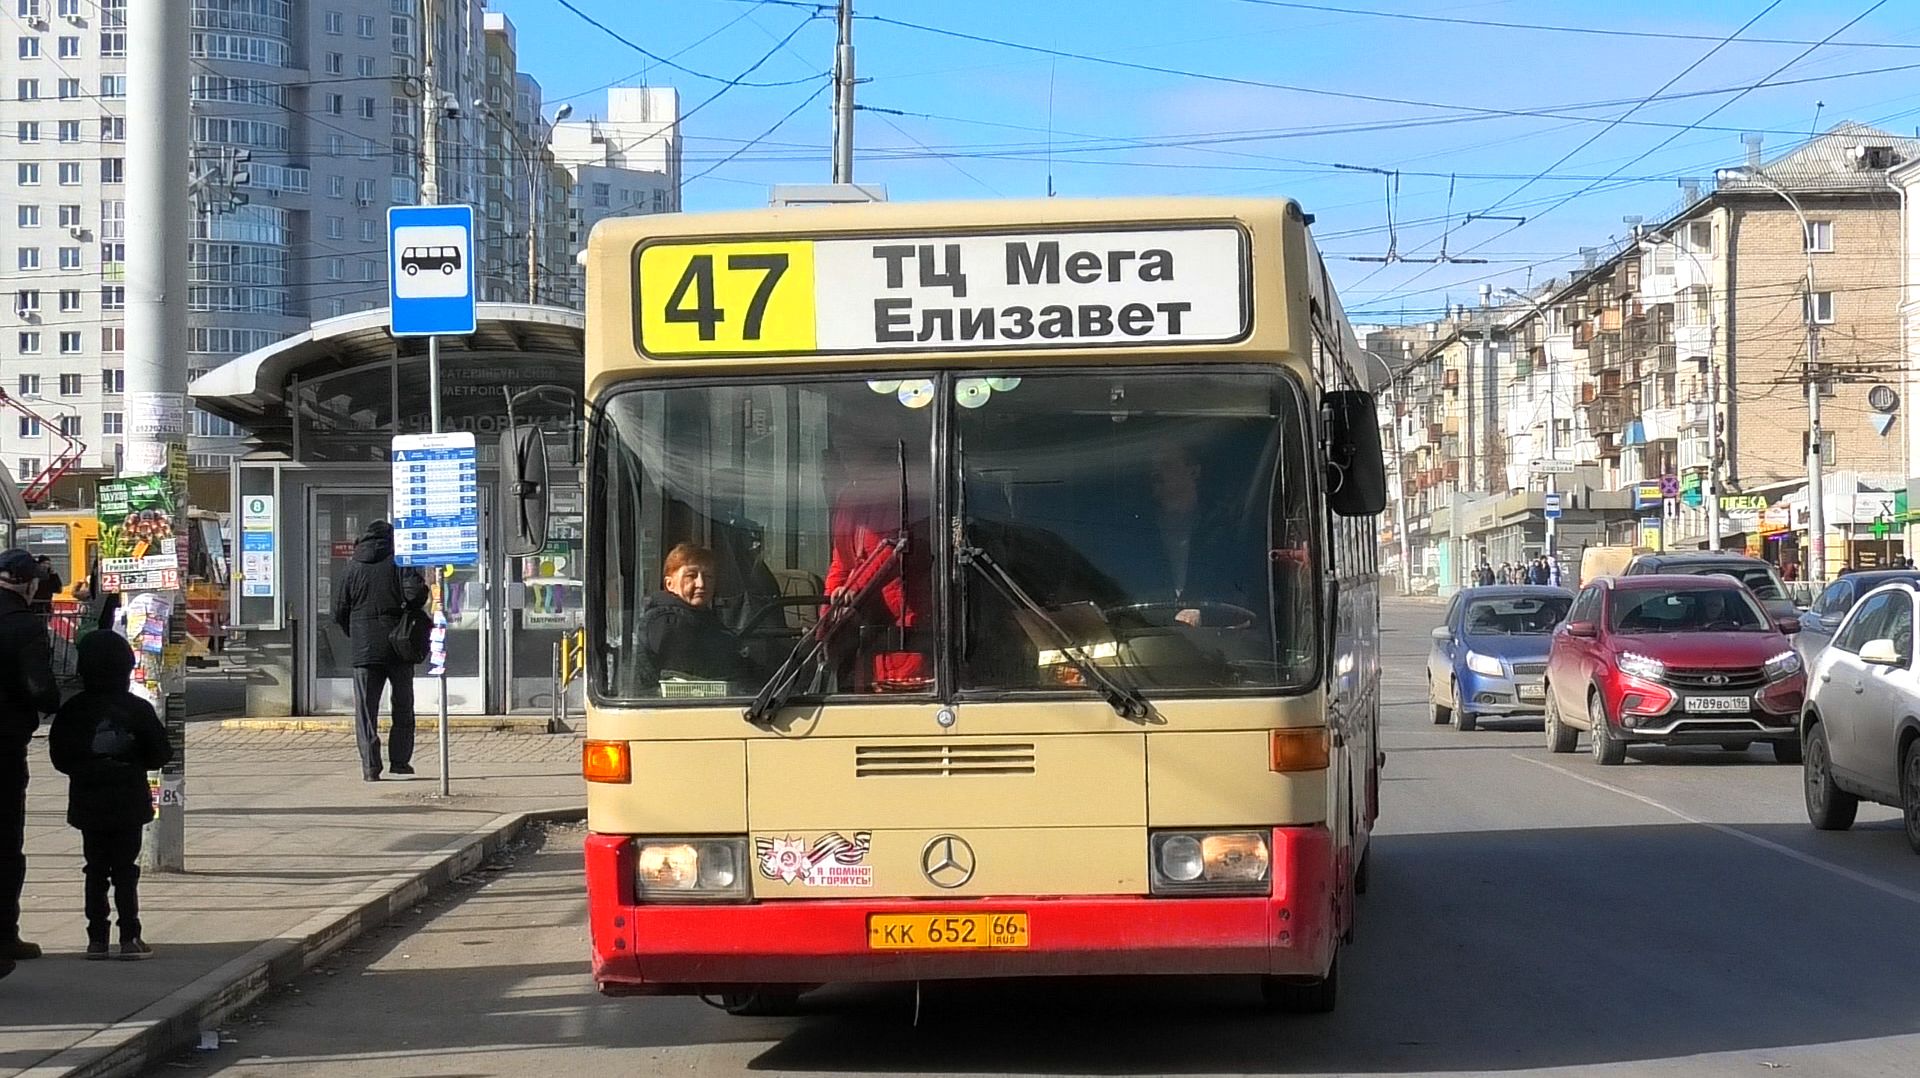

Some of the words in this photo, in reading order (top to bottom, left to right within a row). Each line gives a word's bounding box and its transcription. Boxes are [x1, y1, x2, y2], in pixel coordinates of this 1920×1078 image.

[873, 244, 966, 297] ТЦ
[1005, 241, 1174, 285] Мега
[664, 252, 790, 342] 47
[874, 298, 1191, 343] Елизавет
[253, 500, 262, 512] 8
[1720, 495, 1767, 509] ПТЕКА
[103, 574, 120, 586] 23
[162, 571, 177, 583] 19
[817, 867, 824, 876] Я
[829, 867, 871, 876] ПОМНЮ!
[808, 876, 816, 885] Я
[820, 876, 871, 885] ГОРЖУСЬ!
[927, 918, 977, 943] 652
[992, 916, 1018, 935] 66
[995, 935, 1016, 945] RUS
